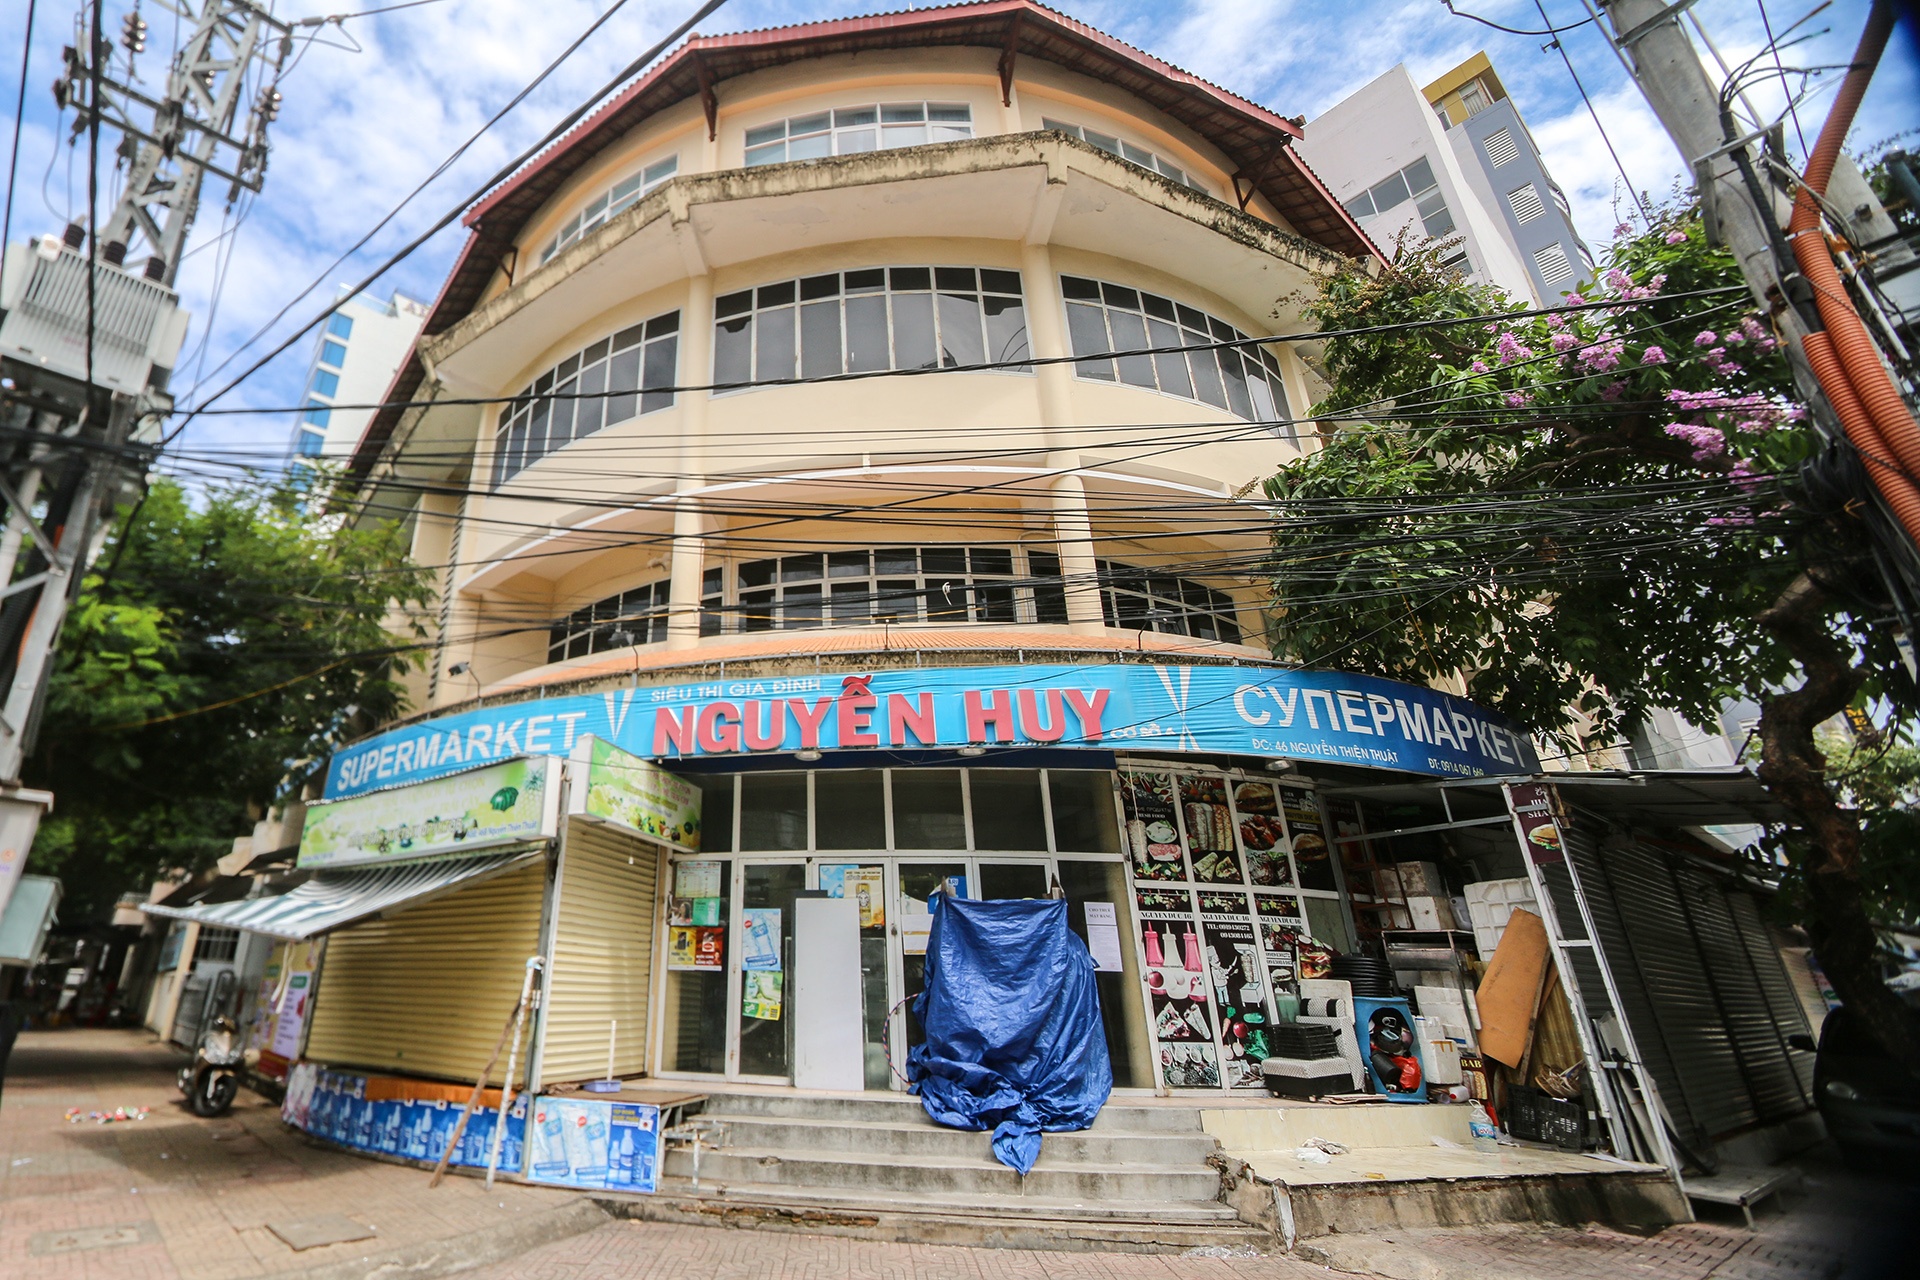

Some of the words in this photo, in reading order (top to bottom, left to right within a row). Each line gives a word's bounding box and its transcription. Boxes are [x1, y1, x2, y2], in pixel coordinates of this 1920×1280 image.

[651, 687, 692, 702] SIÊU
[729, 683, 765, 697] GIA
[772, 677, 820, 693] ĐÌNH
[652, 675, 936, 757] NGUYỄN
[964, 688, 1111, 744] HUY
[337, 711, 587, 792] SUPERMARKET
[1233, 684, 1526, 768] СУПЕРМАРКЕТ
[1252, 738, 1273, 751] ĐC:
[1275, 741, 1288, 752] 46
[1290, 739, 1338, 756] NGUYỄN
[1339, 744, 1370, 761] THIỆN
[1370, 749, 1399, 765] THUẬT
[1441, 760, 1459, 773] 0914
